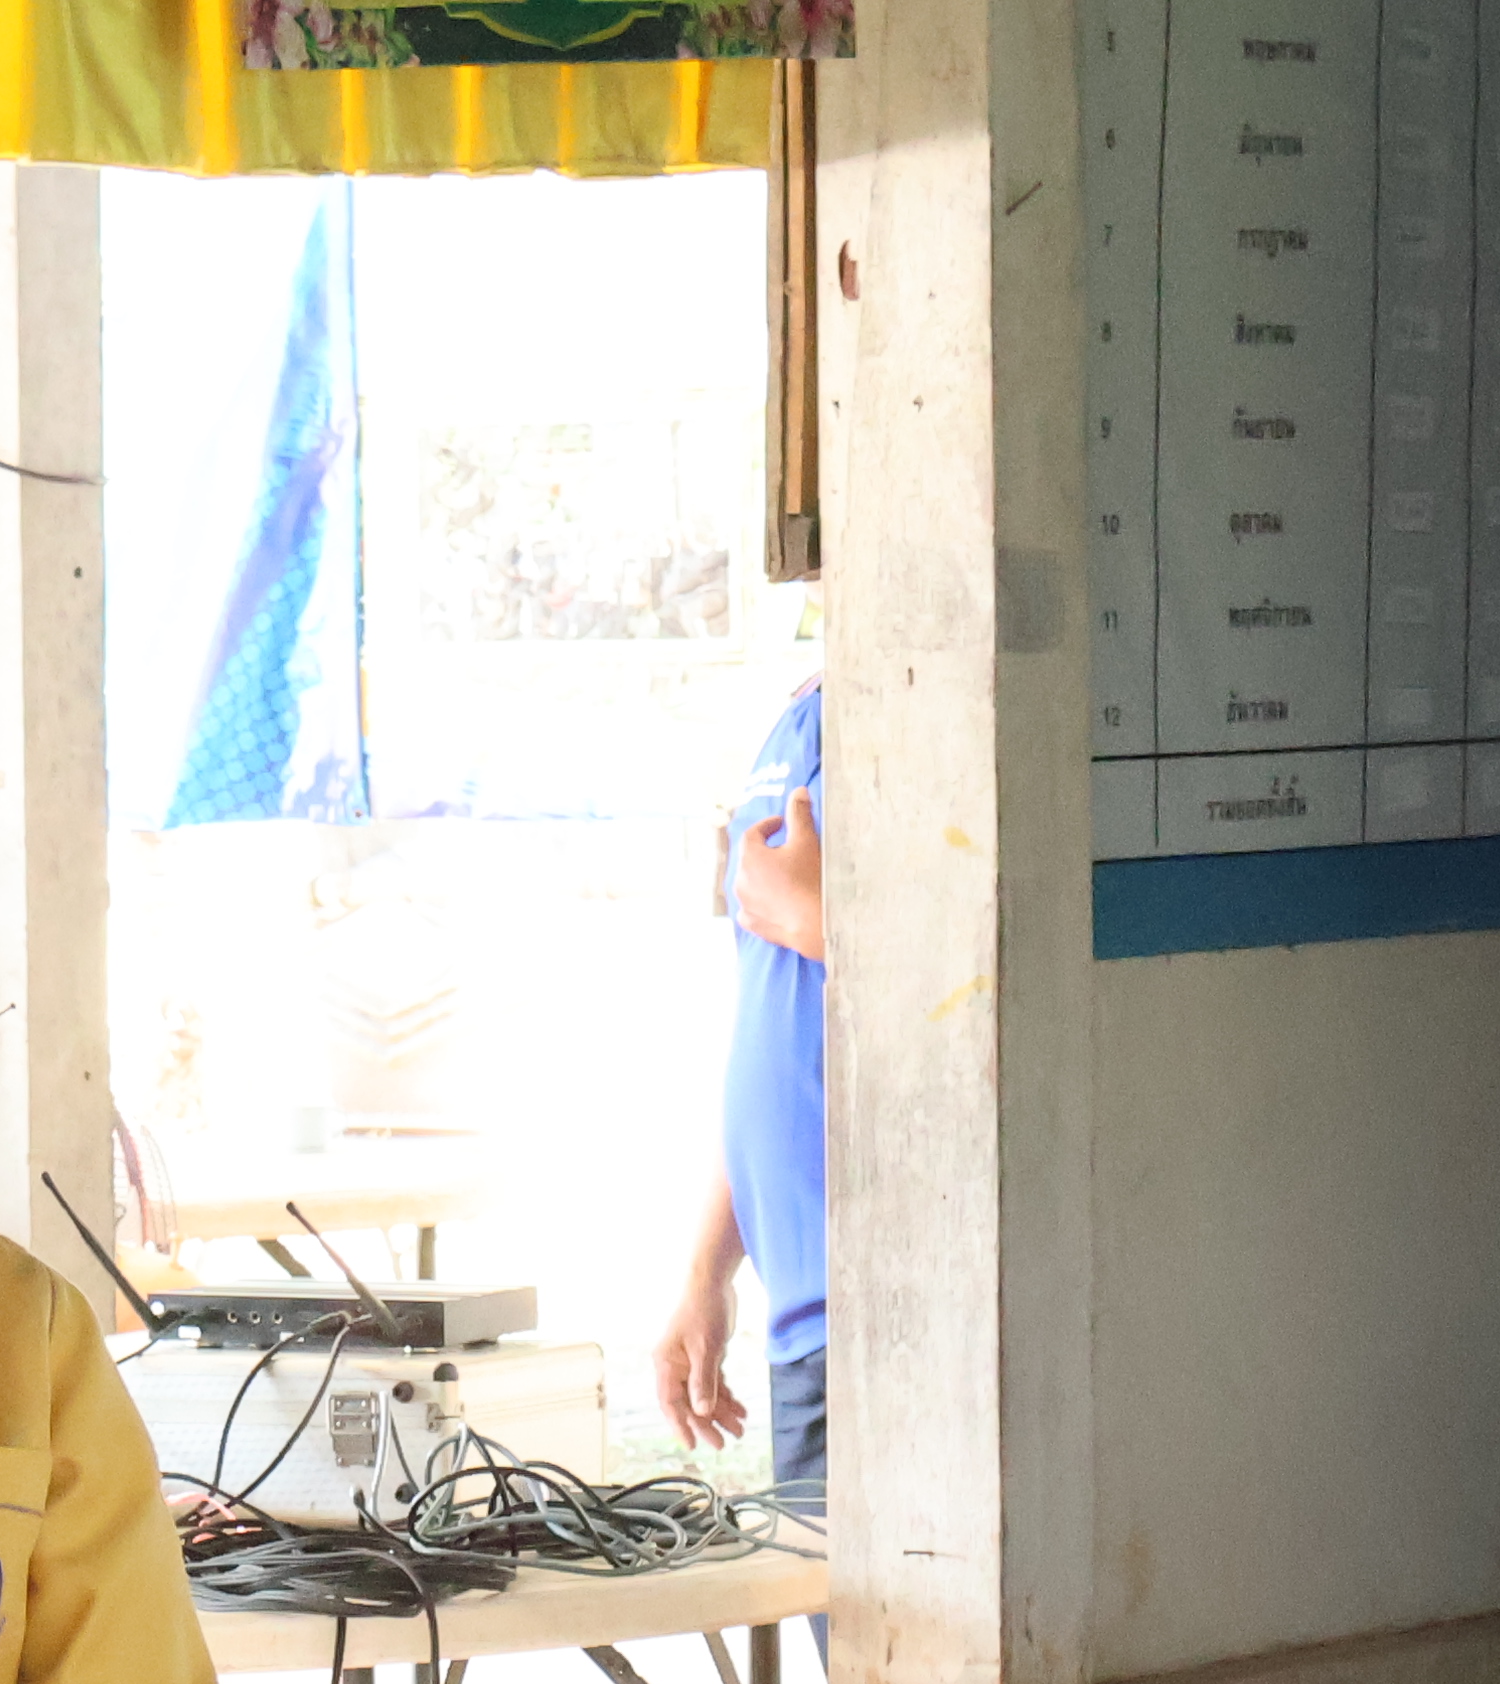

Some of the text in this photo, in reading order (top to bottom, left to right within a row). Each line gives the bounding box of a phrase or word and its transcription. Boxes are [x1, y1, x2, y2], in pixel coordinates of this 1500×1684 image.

[1101, 513, 1120, 538] 10
[1102, 609, 1119, 633] 11
[1103, 704, 1121, 729] 12
